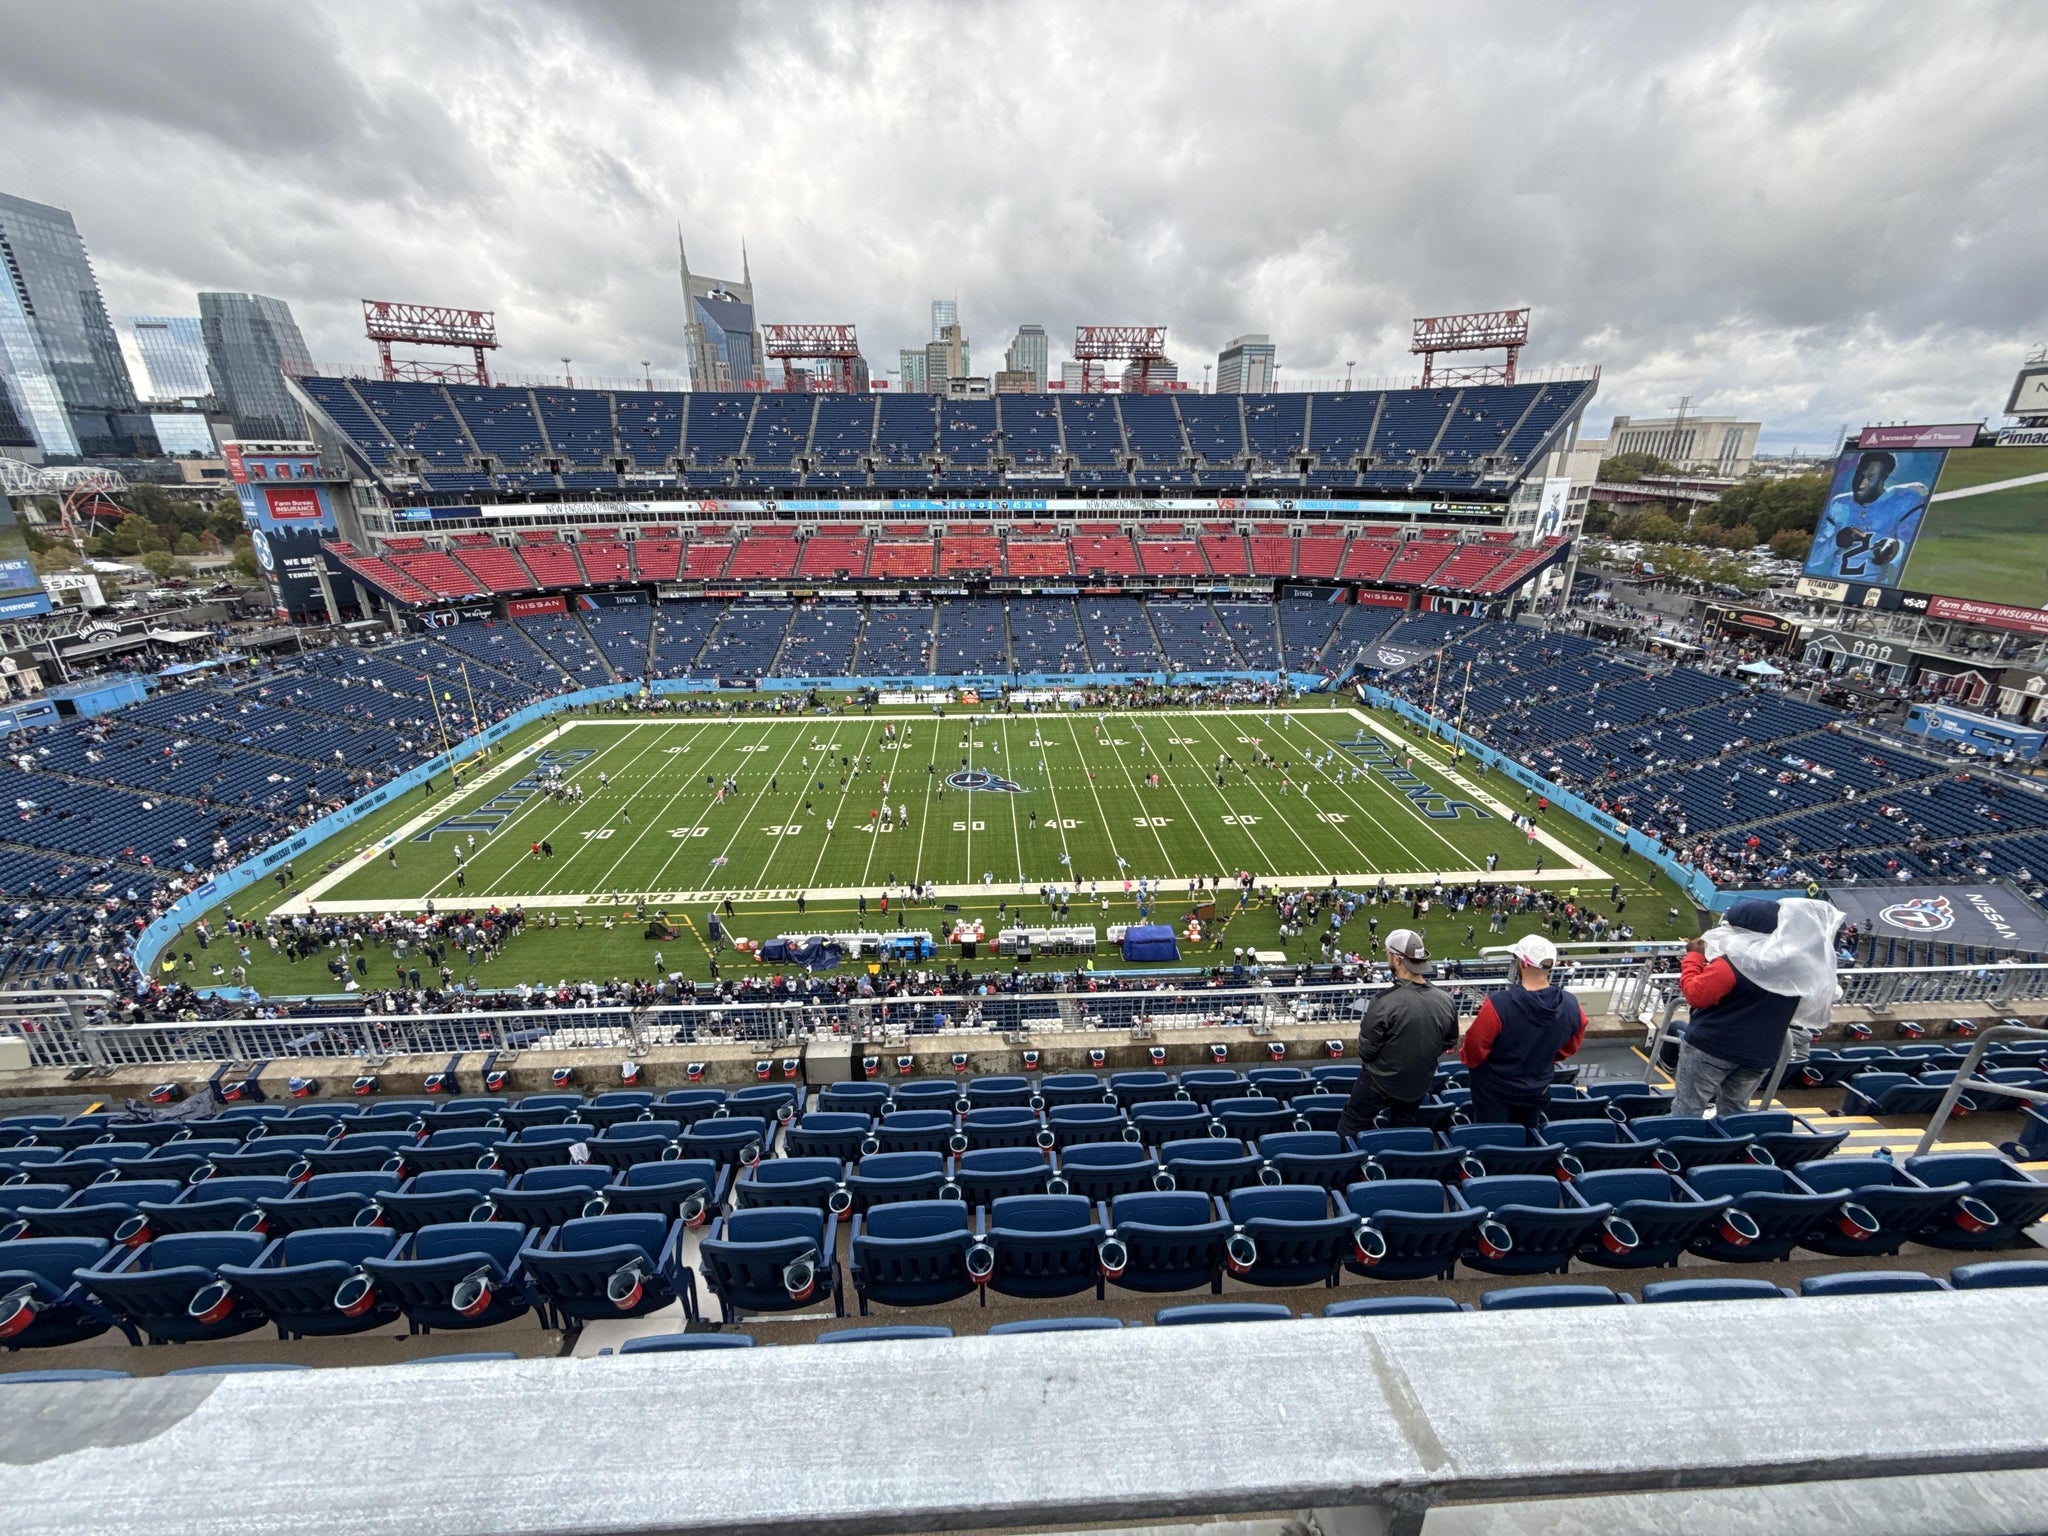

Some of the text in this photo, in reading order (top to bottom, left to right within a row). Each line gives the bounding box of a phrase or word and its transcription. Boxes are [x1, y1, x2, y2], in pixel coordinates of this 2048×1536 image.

[546, 502, 630, 514] NEW ENGLAND PATRIOTS
[697, 501, 719, 511] VS
[1217, 500, 1235, 509] VS
[283, 558, 299, 566] WE
[1807, 579, 1828, 589] TITAN
[1363, 592, 1403, 602] NISSAN
[516, 599, 560, 611] NISSAN
[1936, 600, 1960, 610] Farm
[1961, 603, 1996, 615] Bureau
[77, 622, 95, 640] JACK
[353, 799, 374, 816] TENNESSEE
[1132, 817, 1167, 827] 30
[1221, 815, 1256, 825] 20
[1315, 813, 1344, 823] 10
[1590, 811, 1614, 831] TENNESSEE
[861, 823, 894, 833] 40
[953, 821, 986, 831] 50
[1044, 819, 1078, 829] 40
[584, 829, 617, 840] 10
[671, 827, 710, 838] 20
[766, 825, 803, 836] 30
[263, 837, 308, 868] TENNESSEE TOUGH
[1966, 893, 2021, 941] NISSAN
